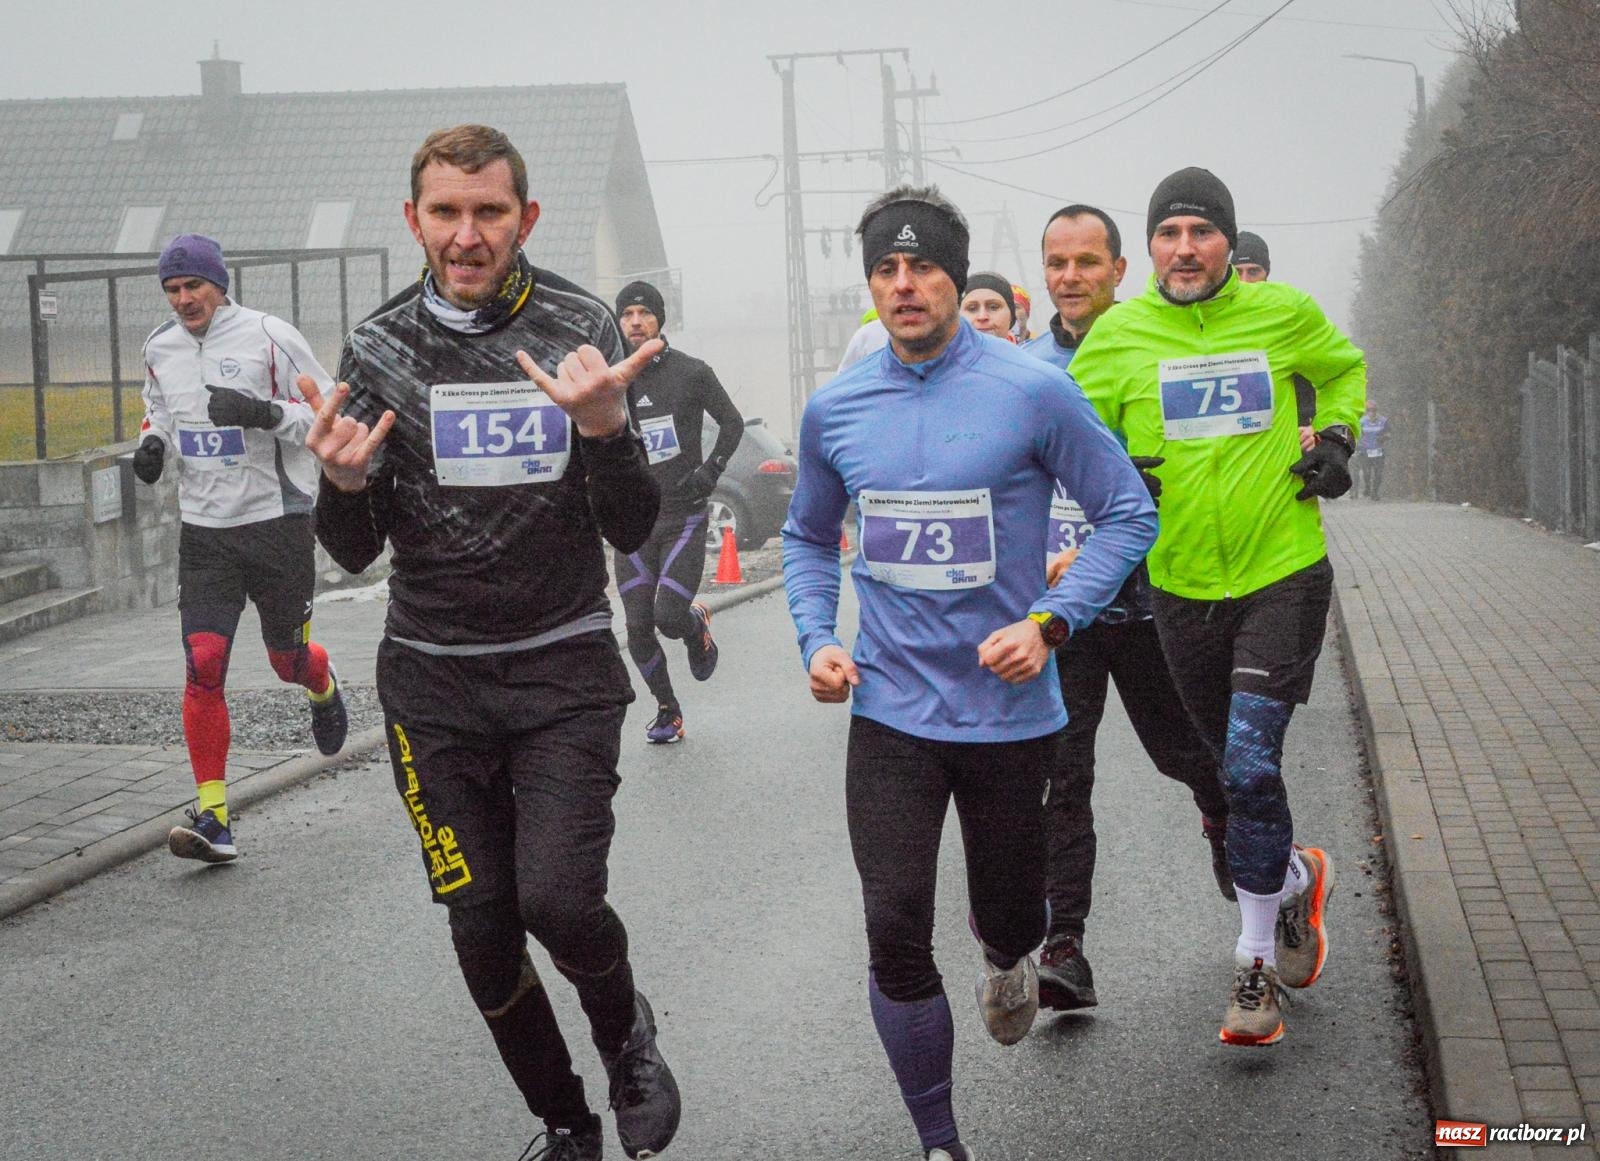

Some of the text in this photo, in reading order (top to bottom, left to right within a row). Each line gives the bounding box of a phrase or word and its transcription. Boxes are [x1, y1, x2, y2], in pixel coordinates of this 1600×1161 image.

[490, 388, 510, 396] Ziemi
[1192, 377, 1242, 415] 75
[193, 432, 223, 456] 19
[458, 410, 547, 455] 154
[913, 498, 932, 506] Ziemi
[932, 496, 980, 506] Pietrowickiej
[895, 521, 954, 562] 73
